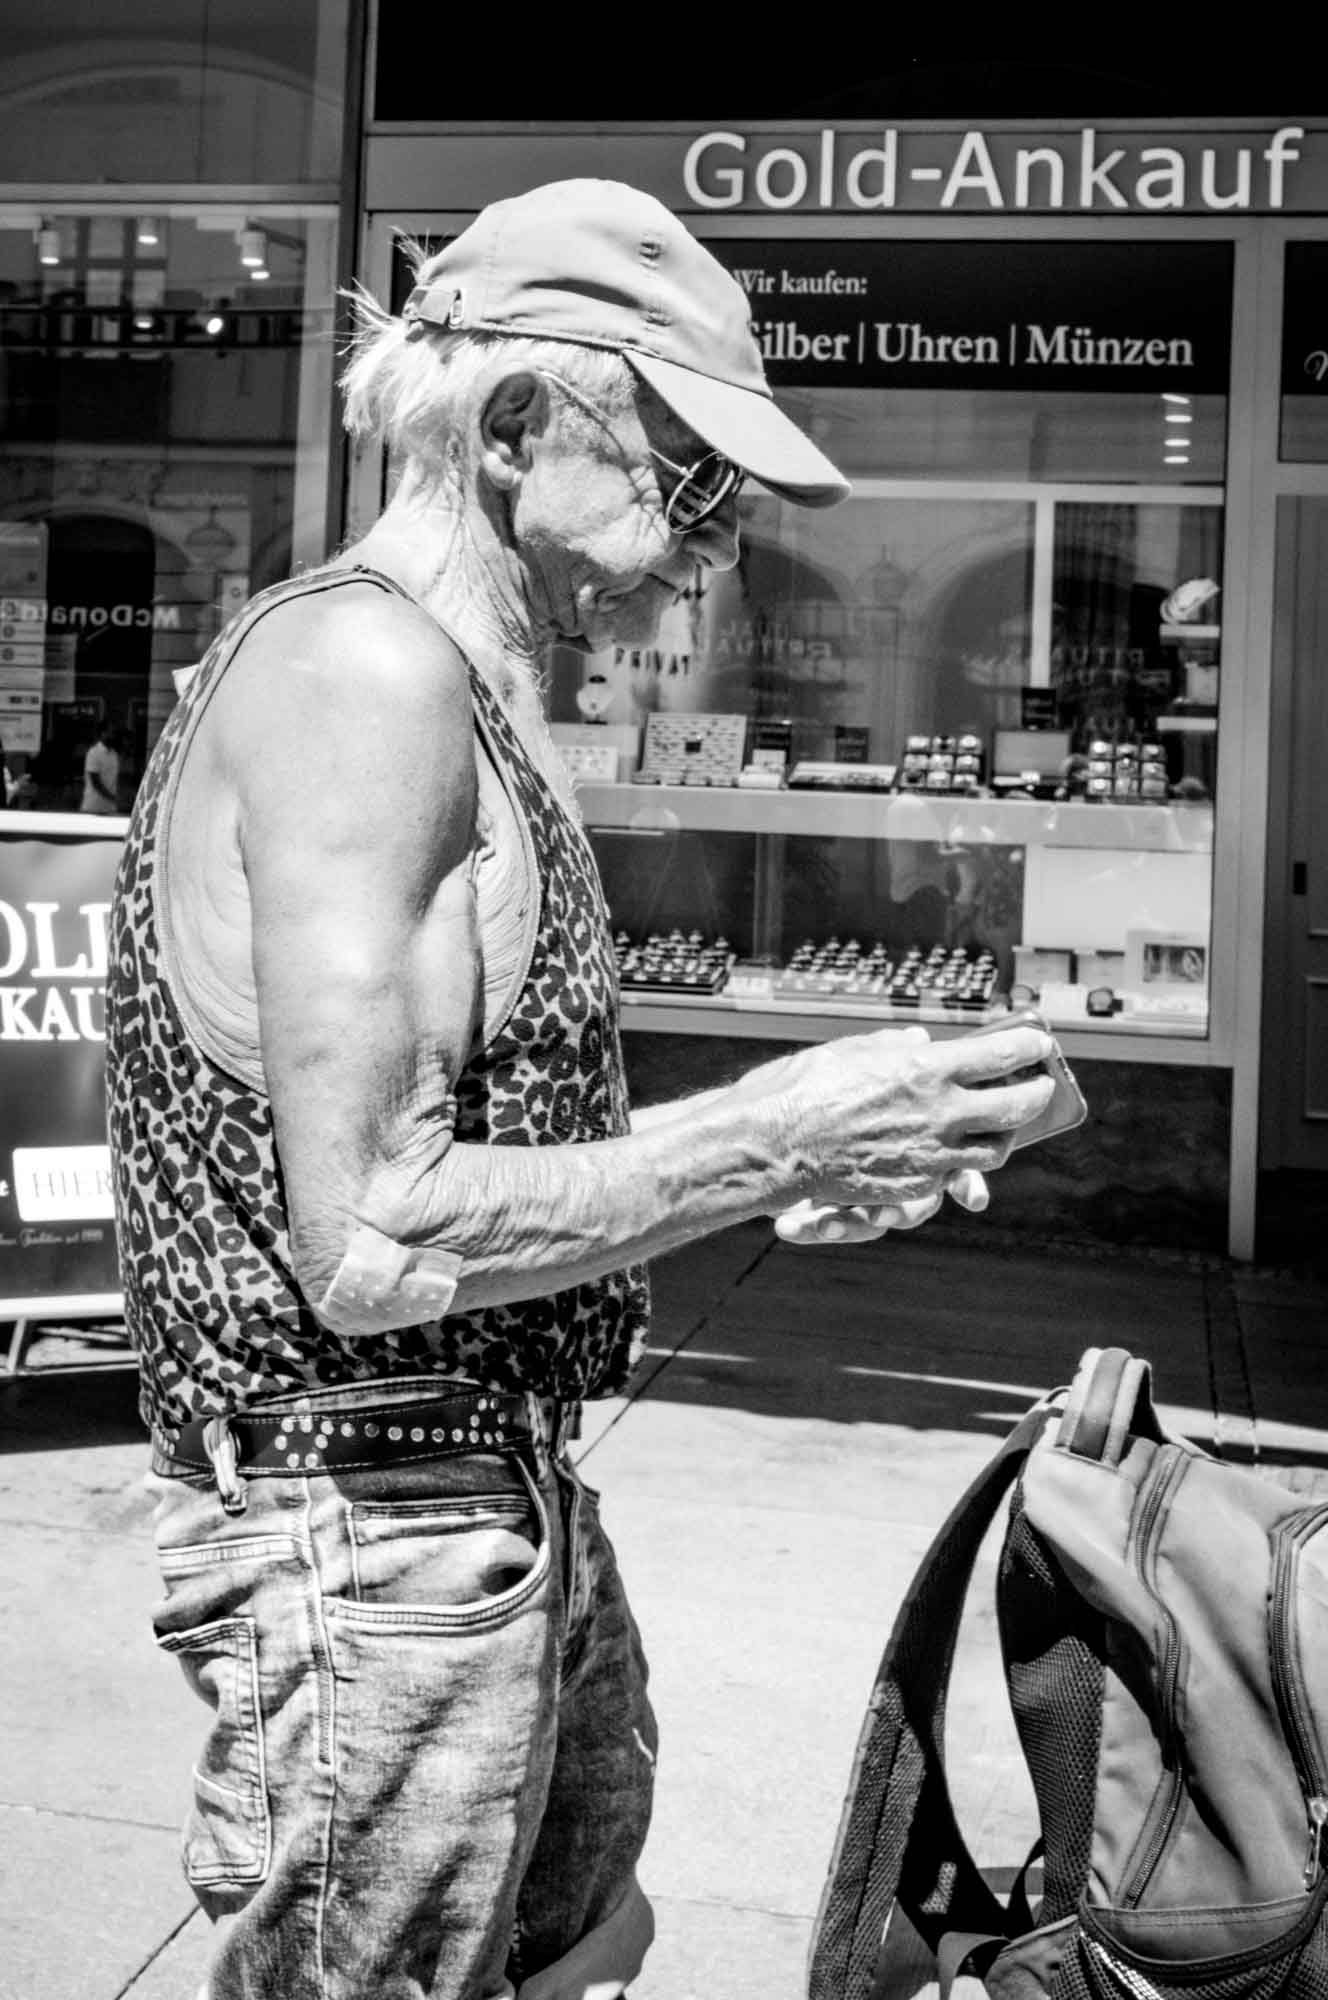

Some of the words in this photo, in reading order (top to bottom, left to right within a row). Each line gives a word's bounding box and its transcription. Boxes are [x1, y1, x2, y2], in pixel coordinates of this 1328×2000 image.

[683, 127, 1304, 209] Gold-Ankauf
[733, 269, 775, 293] Wir
[781, 269, 867, 294] kaufen:
[875, 323, 999, 363] Uhren
[1026, 324, 1193, 366] Münzen
